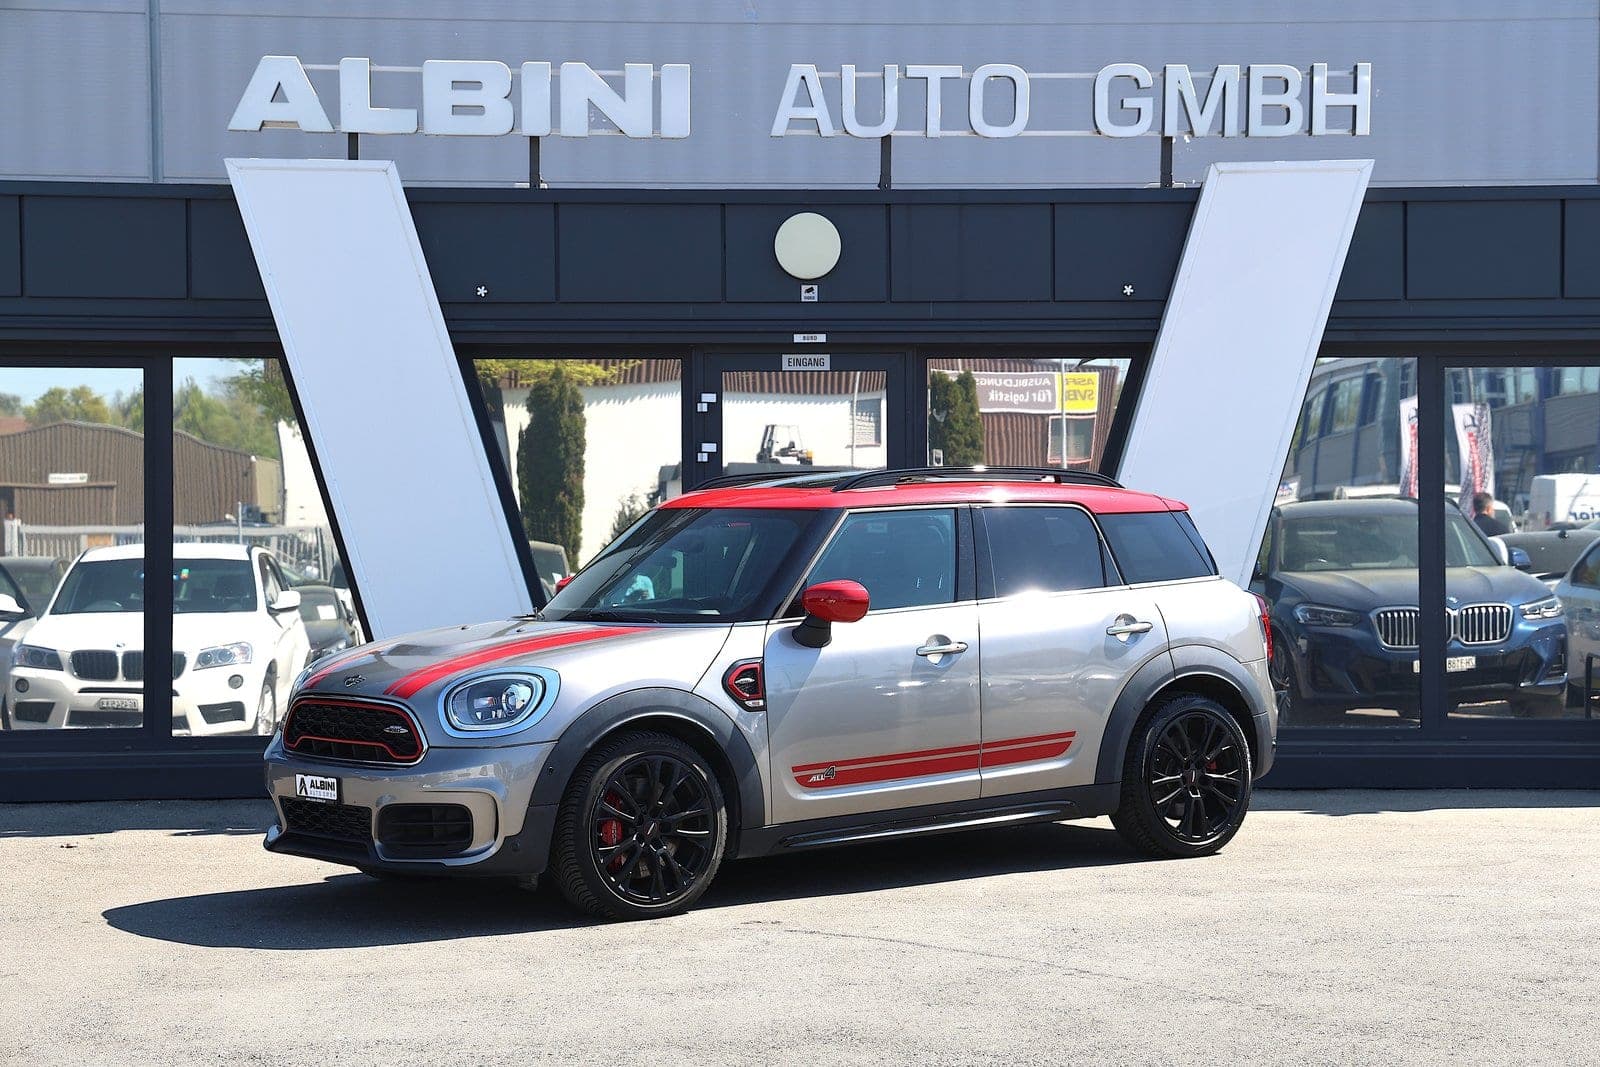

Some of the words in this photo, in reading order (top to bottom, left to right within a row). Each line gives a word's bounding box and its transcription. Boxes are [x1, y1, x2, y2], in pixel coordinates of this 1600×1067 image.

[227, 55, 691, 138] ALBINI
[771, 63, 1030, 139] AUTO
[1095, 62, 1373, 138] GMBH
[787, 357, 825, 367] EINGANG
[310, 779, 335, 791] ALBINI
